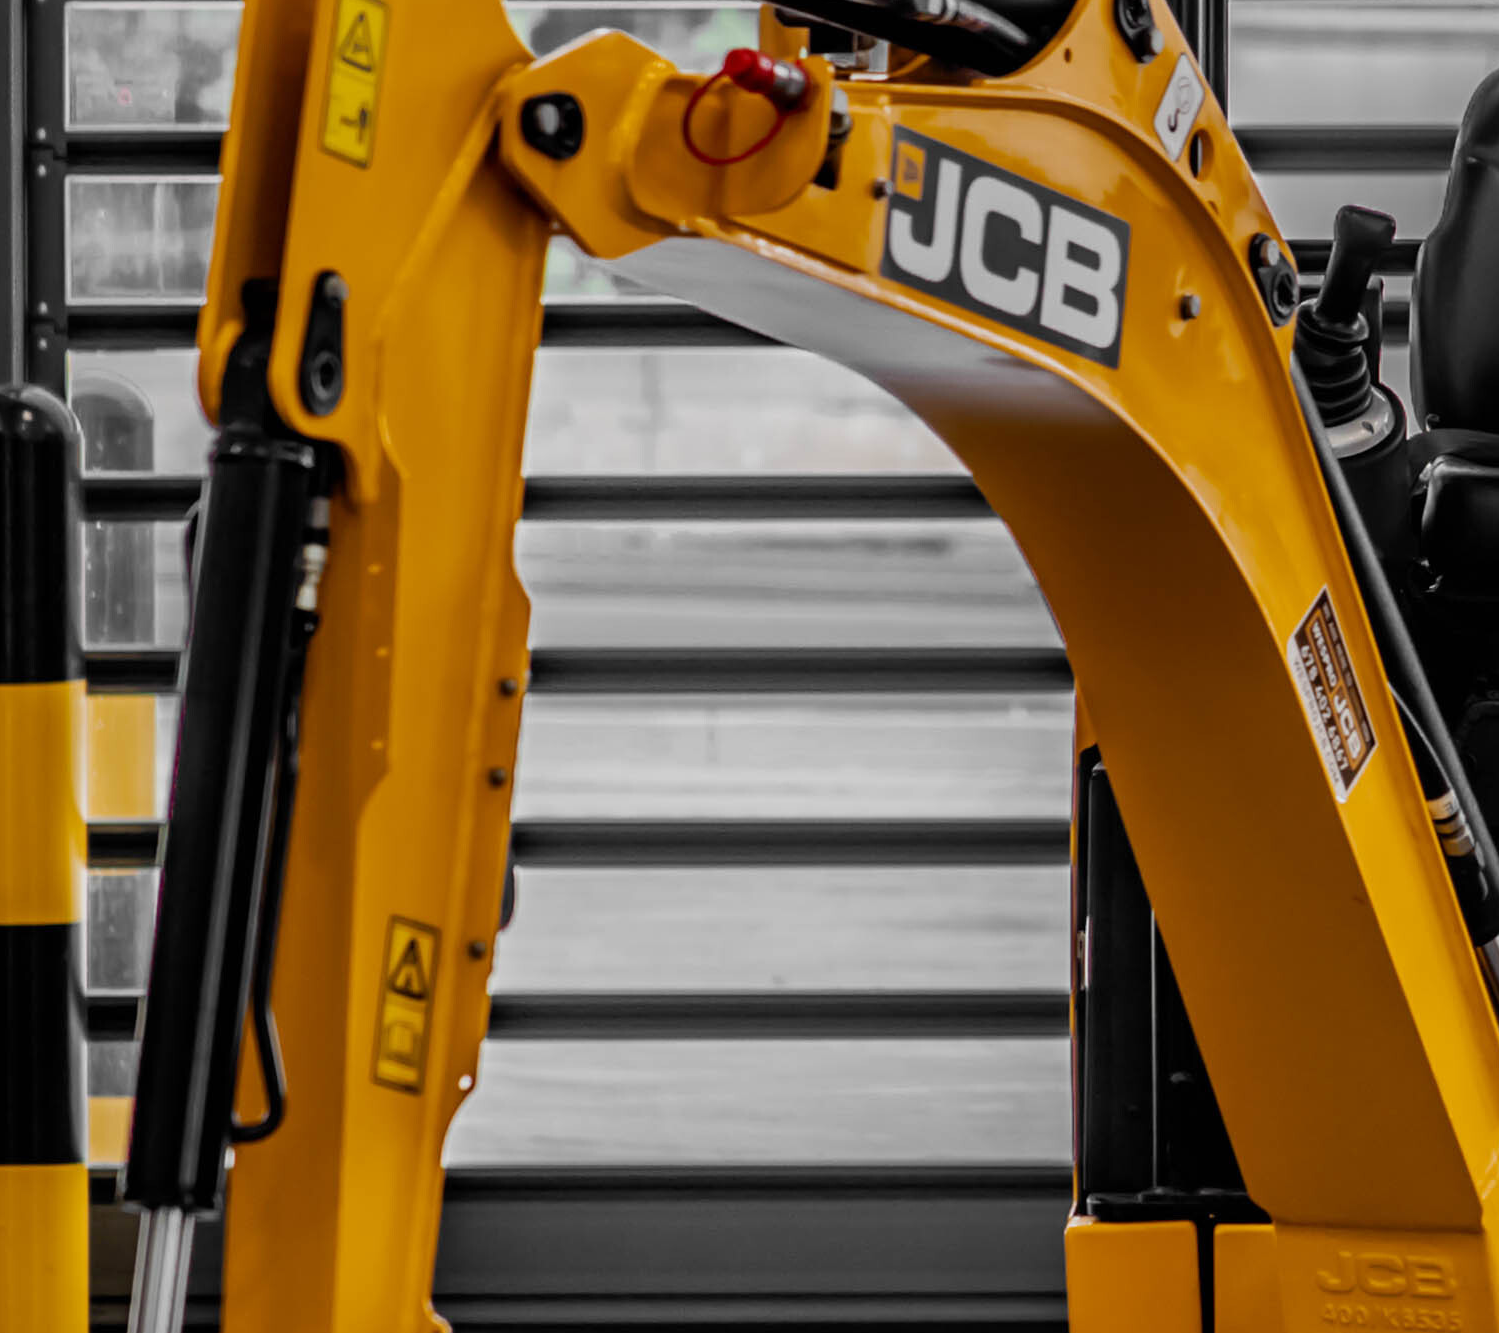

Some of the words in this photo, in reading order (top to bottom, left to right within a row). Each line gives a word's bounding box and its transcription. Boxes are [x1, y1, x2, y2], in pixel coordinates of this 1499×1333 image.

[888, 157, 1122, 349] JCB
[1312, 621, 1337, 688] WESPRO
[1333, 695, 1361, 759] JCB
[1315, 1250, 1458, 1300] JCB
